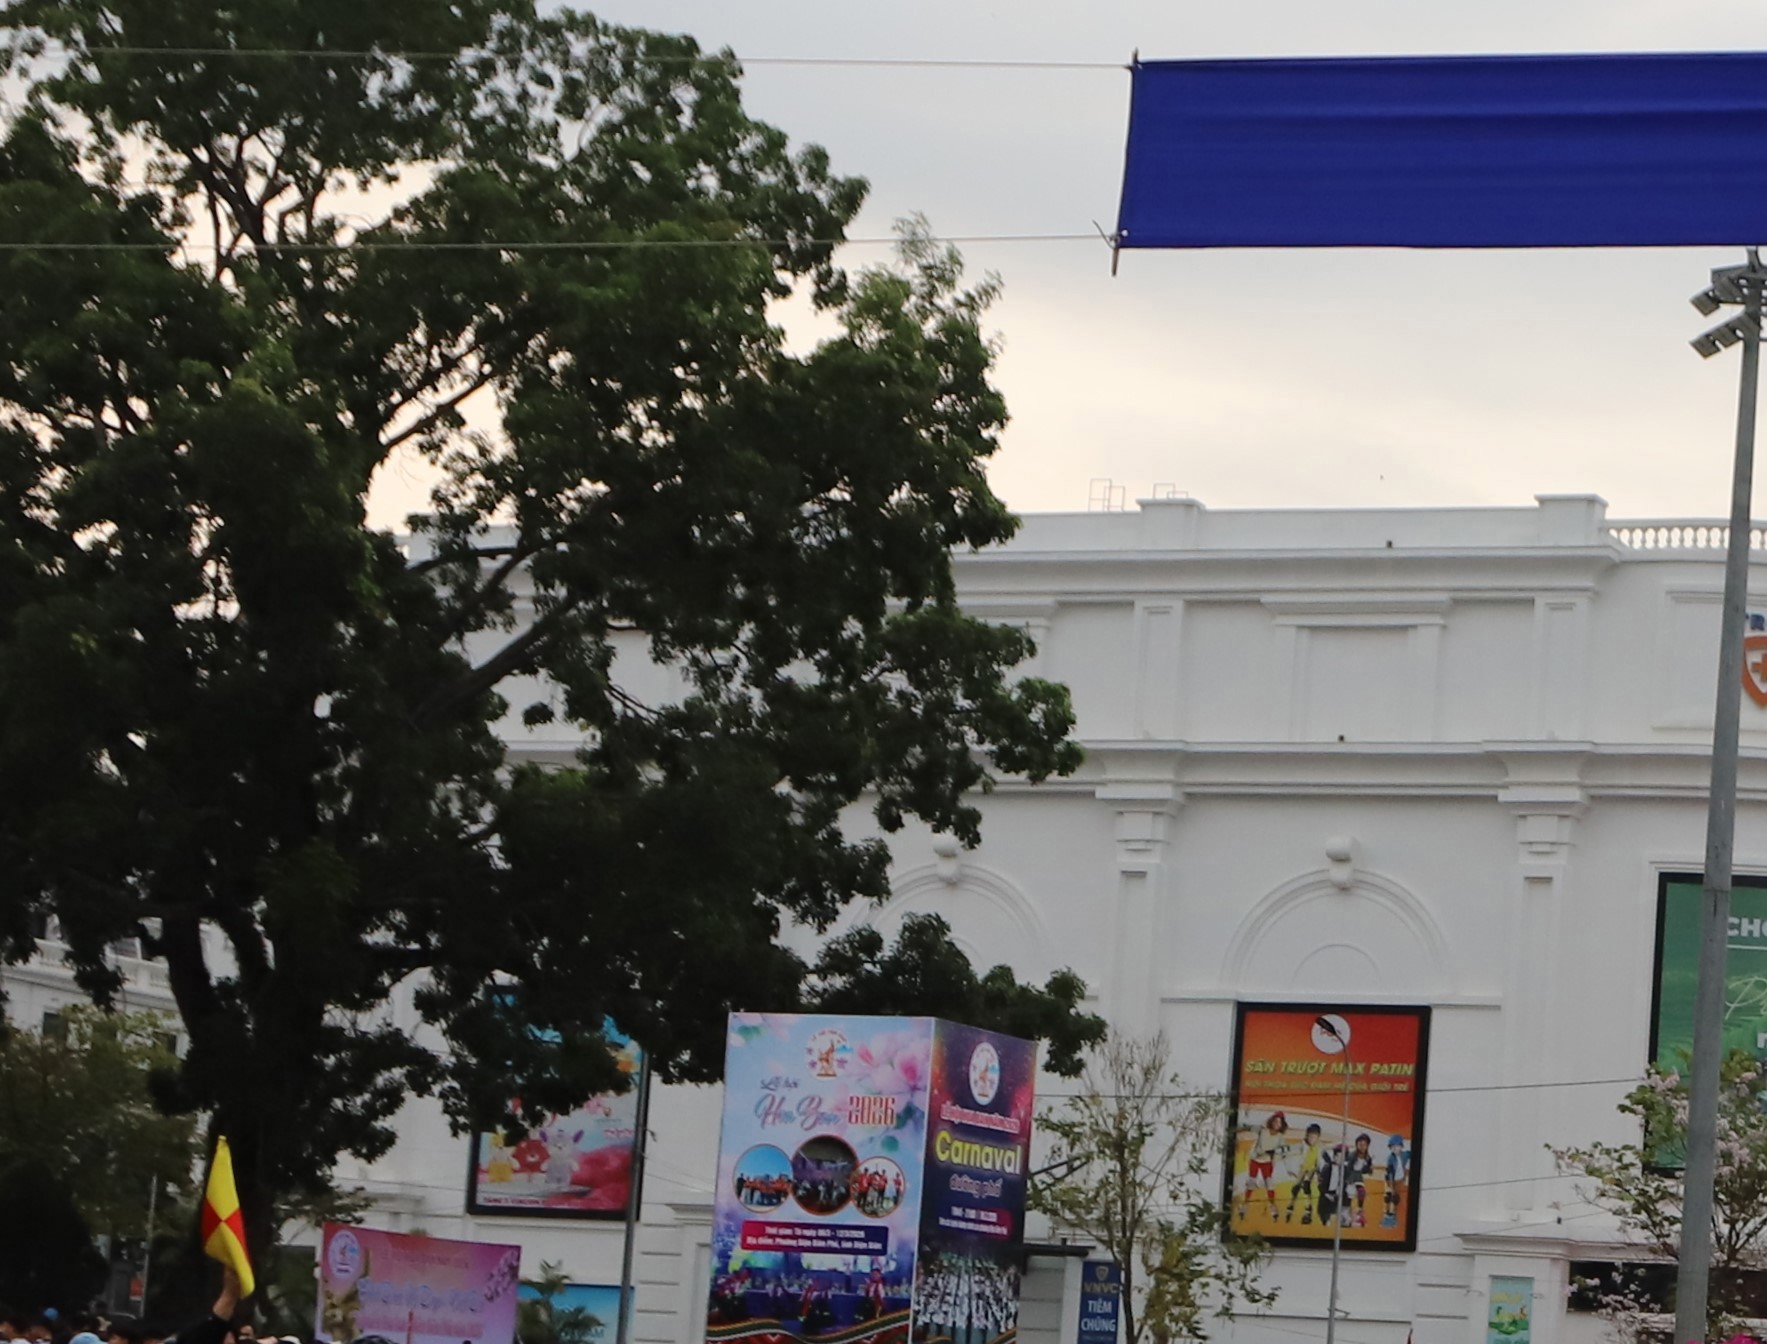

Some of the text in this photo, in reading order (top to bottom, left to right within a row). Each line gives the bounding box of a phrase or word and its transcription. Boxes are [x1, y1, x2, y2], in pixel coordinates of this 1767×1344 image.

[1369, 1062, 1414, 1076] PATIN
[848, 1096, 897, 1126] 2026
[935, 1130, 1022, 1175] Carnaval
